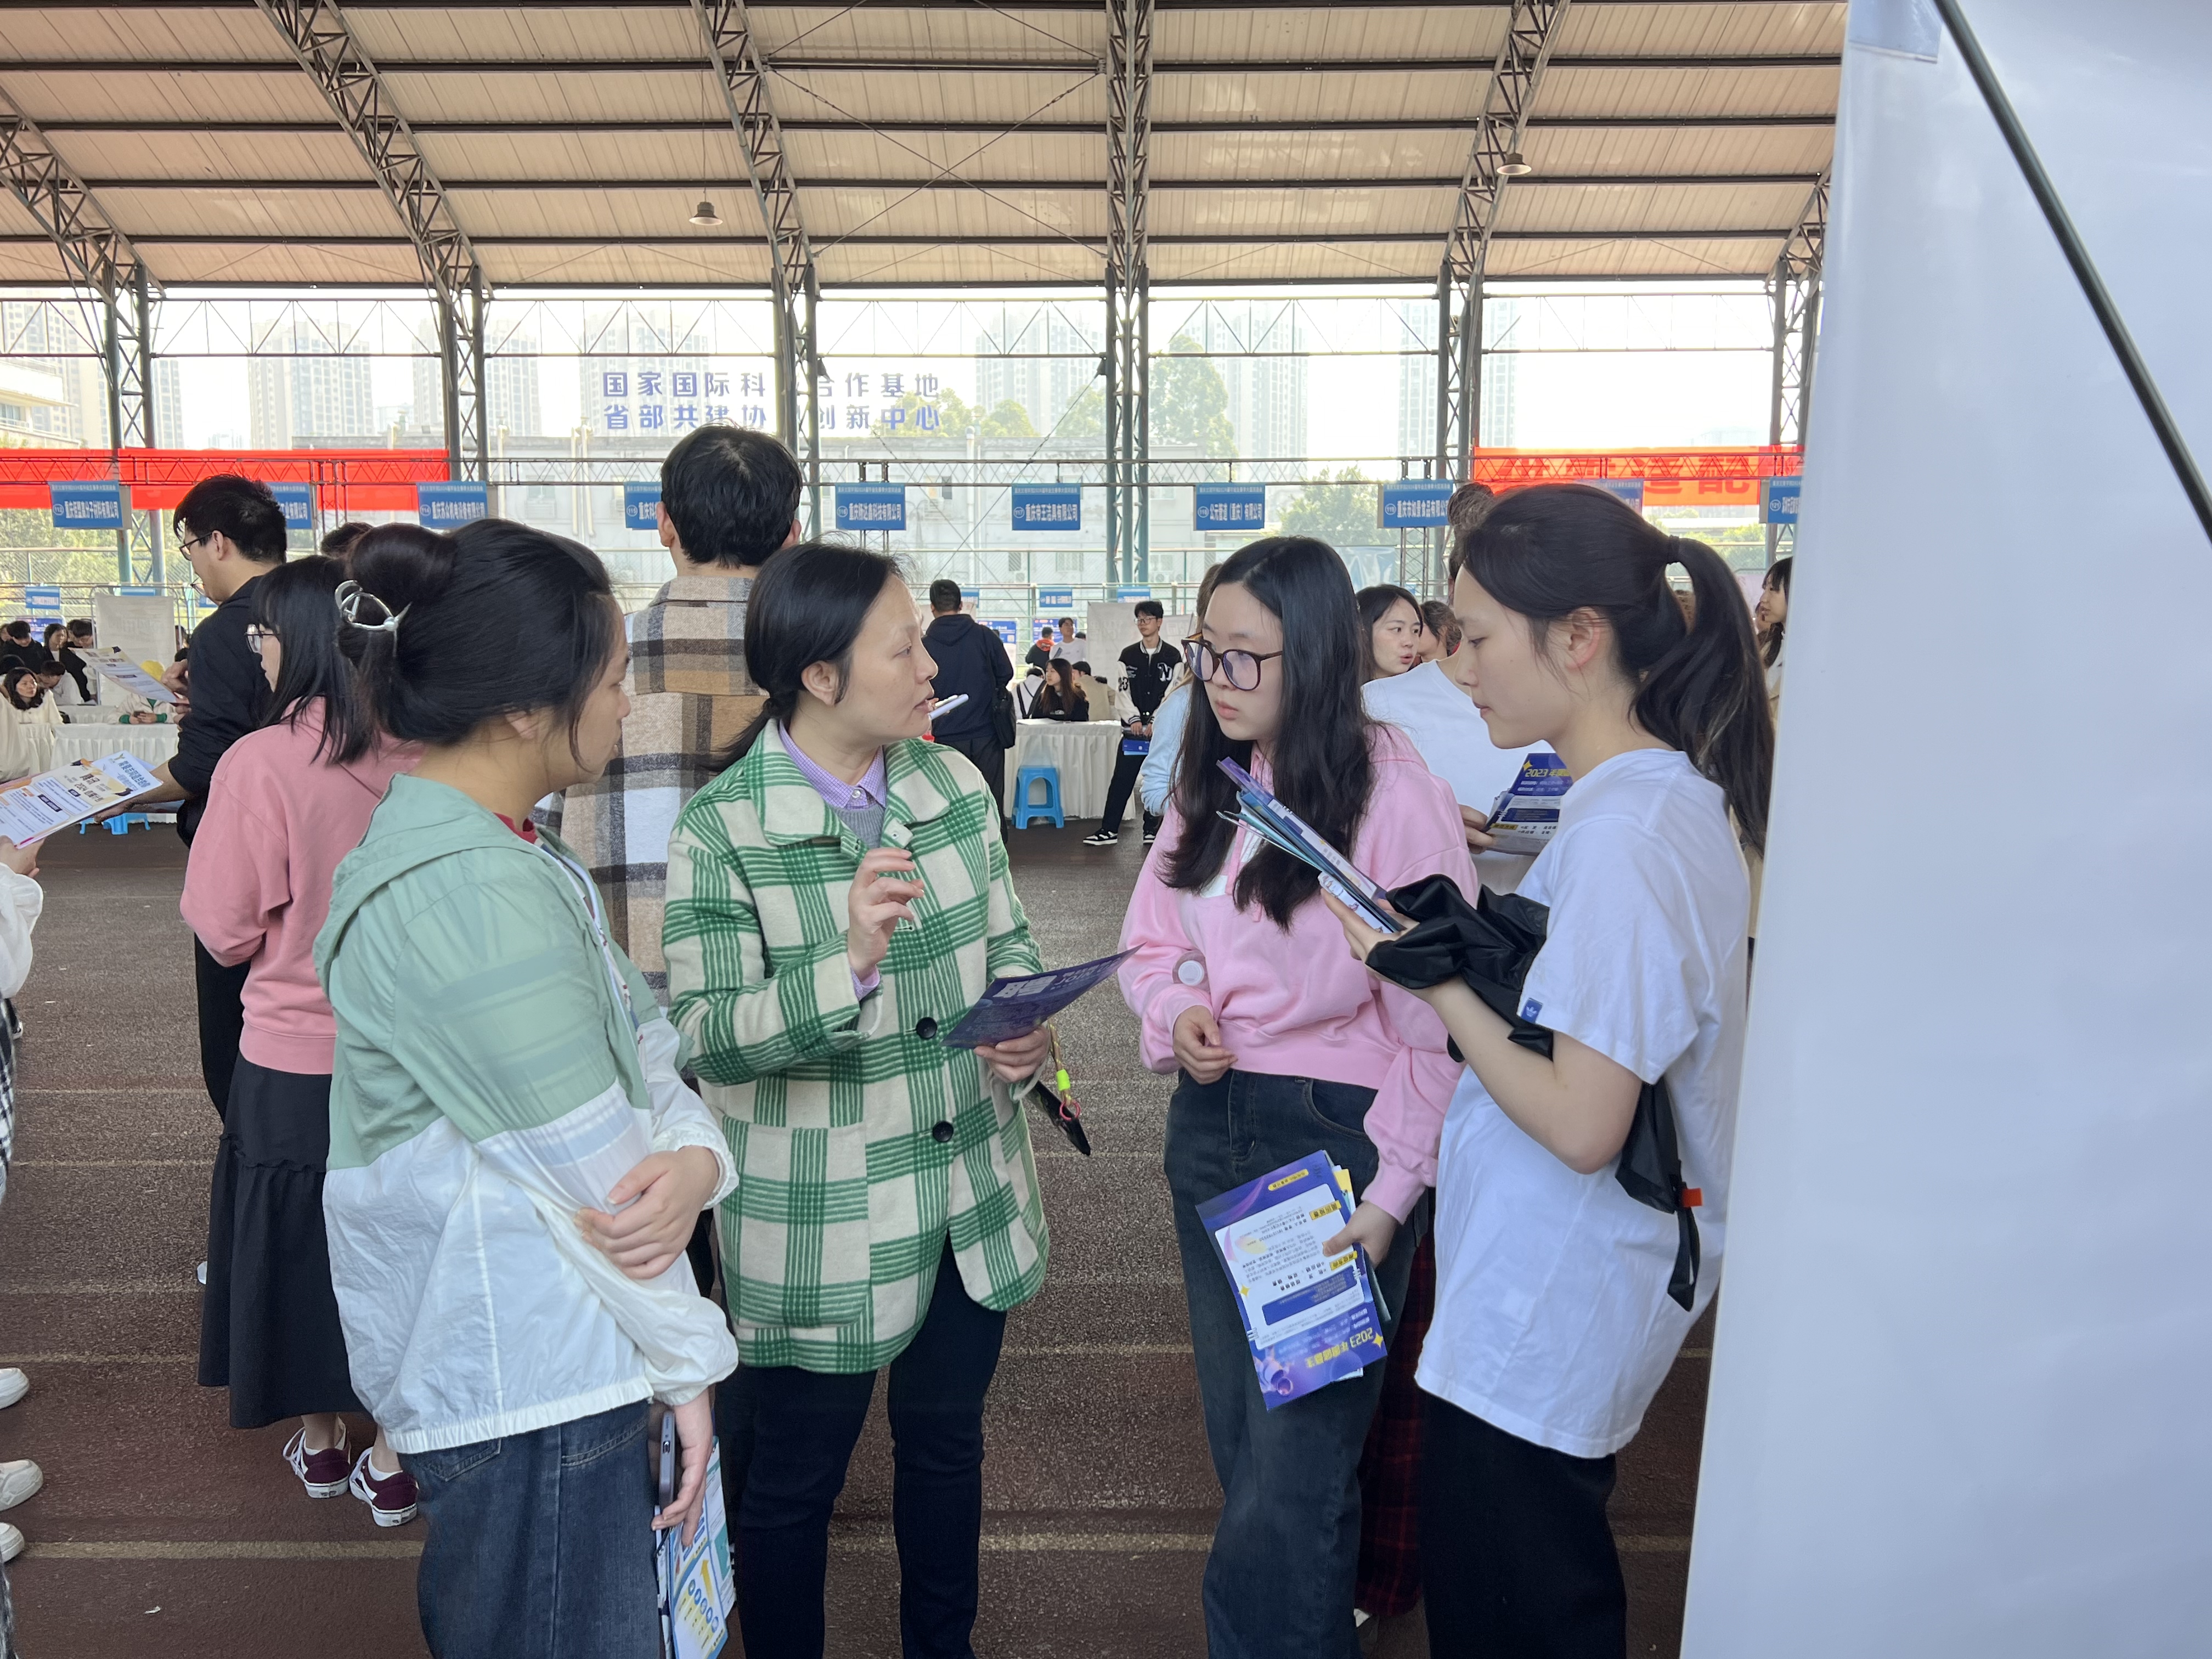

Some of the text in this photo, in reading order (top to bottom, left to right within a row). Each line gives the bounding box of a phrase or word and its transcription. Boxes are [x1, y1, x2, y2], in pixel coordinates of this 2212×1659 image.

[603, 371, 939, 398] 国家国际科合作基地
[604, 404, 939, 430] 省部共建协创新中心
[639, 501, 658, 520] 重庆科
